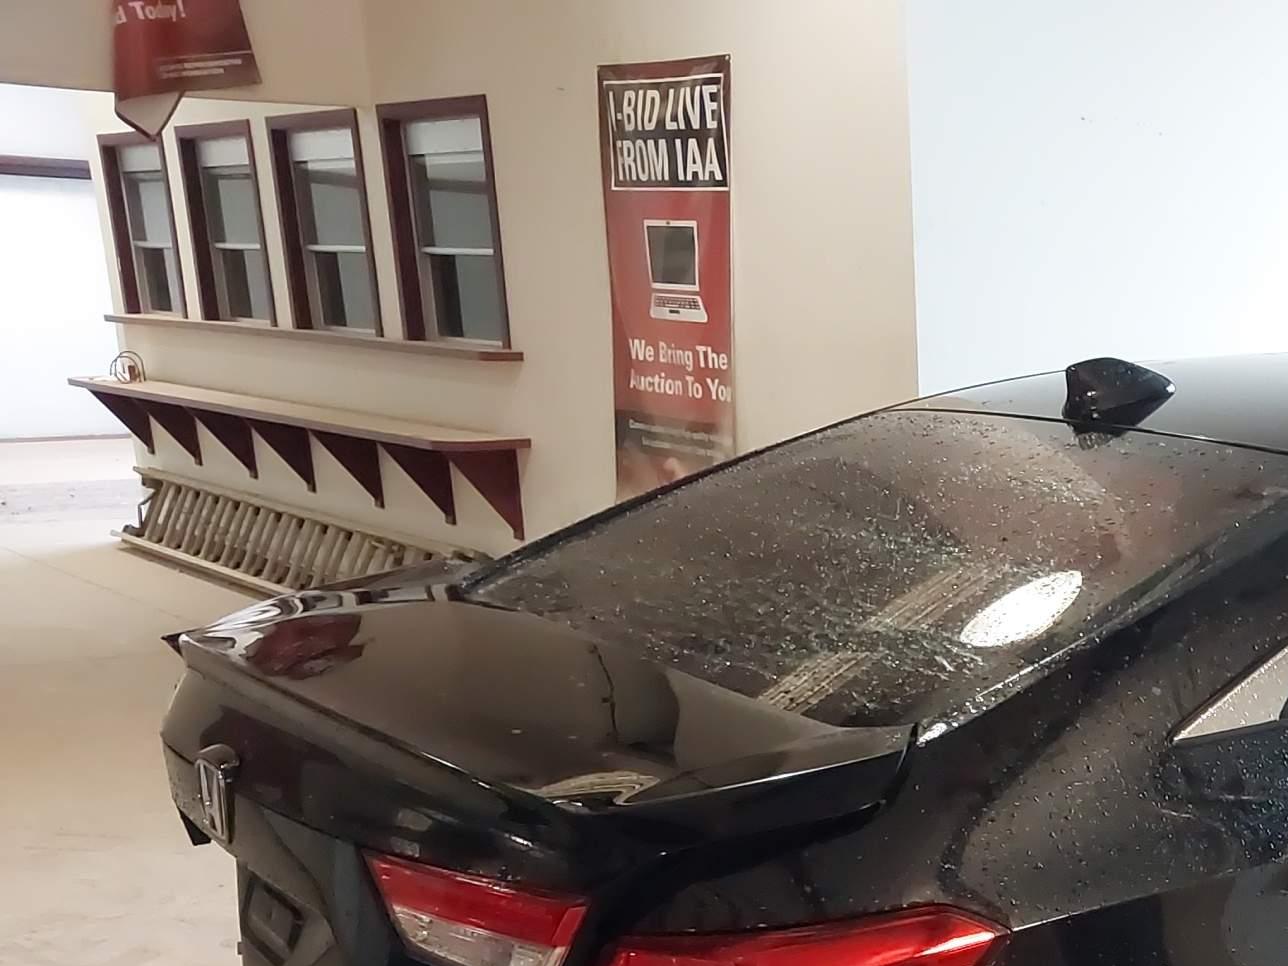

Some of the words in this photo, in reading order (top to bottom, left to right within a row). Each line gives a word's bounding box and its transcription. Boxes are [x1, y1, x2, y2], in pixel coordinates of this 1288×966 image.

[608, 88, 661, 132] I-BID
[664, 84, 718, 130] LIVE
[616, 138, 670, 182] FROM
[674, 136, 723, 181] IAA
[628, 337, 655, 363] We
[658, 340, 694, 372] Bring
[695, 344, 728, 370] The
[629, 368, 683, 396] Auction
[684, 374, 703, 399] To
